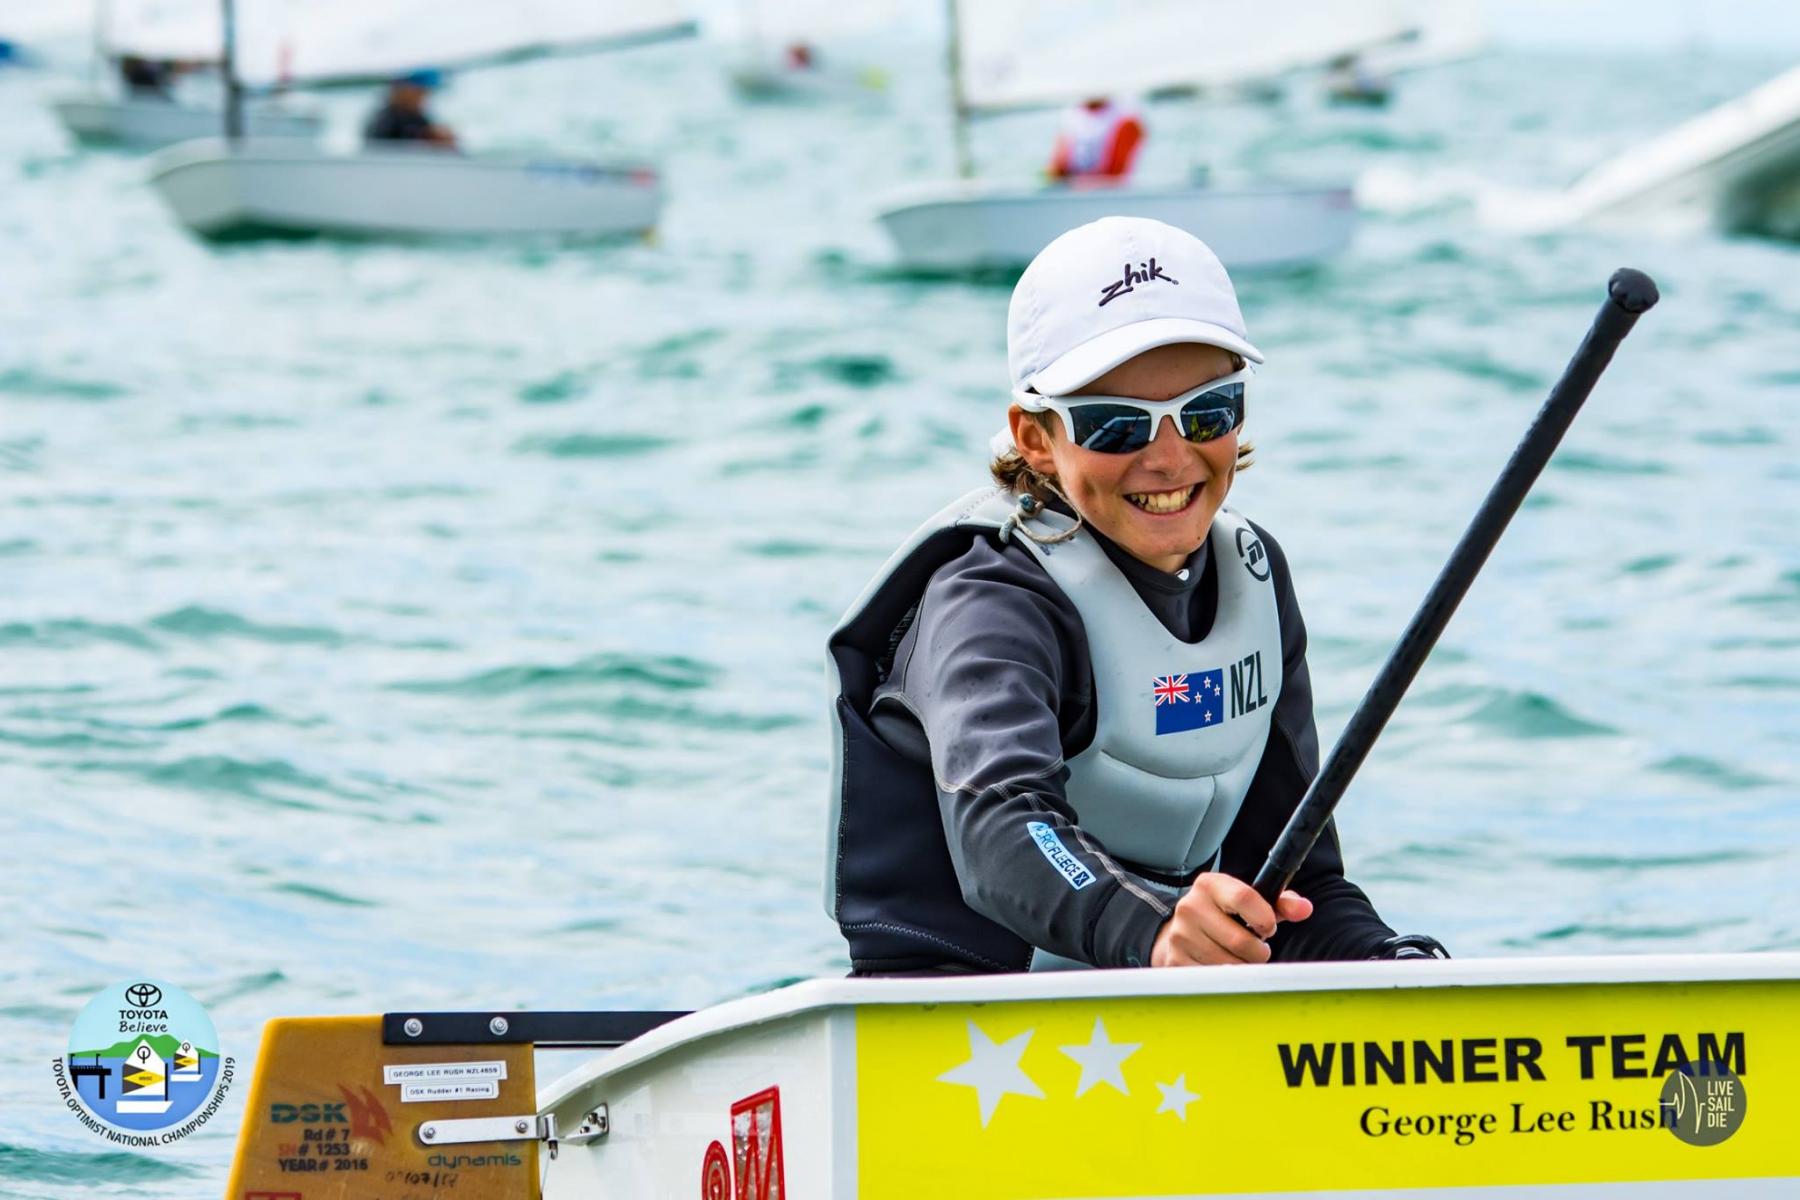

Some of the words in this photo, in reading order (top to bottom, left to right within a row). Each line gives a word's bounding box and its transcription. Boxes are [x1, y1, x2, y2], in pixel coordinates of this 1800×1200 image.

[1098, 257, 1173, 307] zhik
[1230, 650, 1268, 719] NZL
[1277, 1037, 1547, 1088] WINNER
[1566, 1033, 1746, 1080] TEAM
[270, 1103, 348, 1124] DSK
[1360, 1106, 1496, 1146] George
[1511, 1103, 1575, 1133] Lee
[1589, 1099, 1678, 1131] Rush
[316, 1143, 351, 1156] 1253
[341, 1129, 350, 1141] 7
[427, 1152, 522, 1169] dynamis
